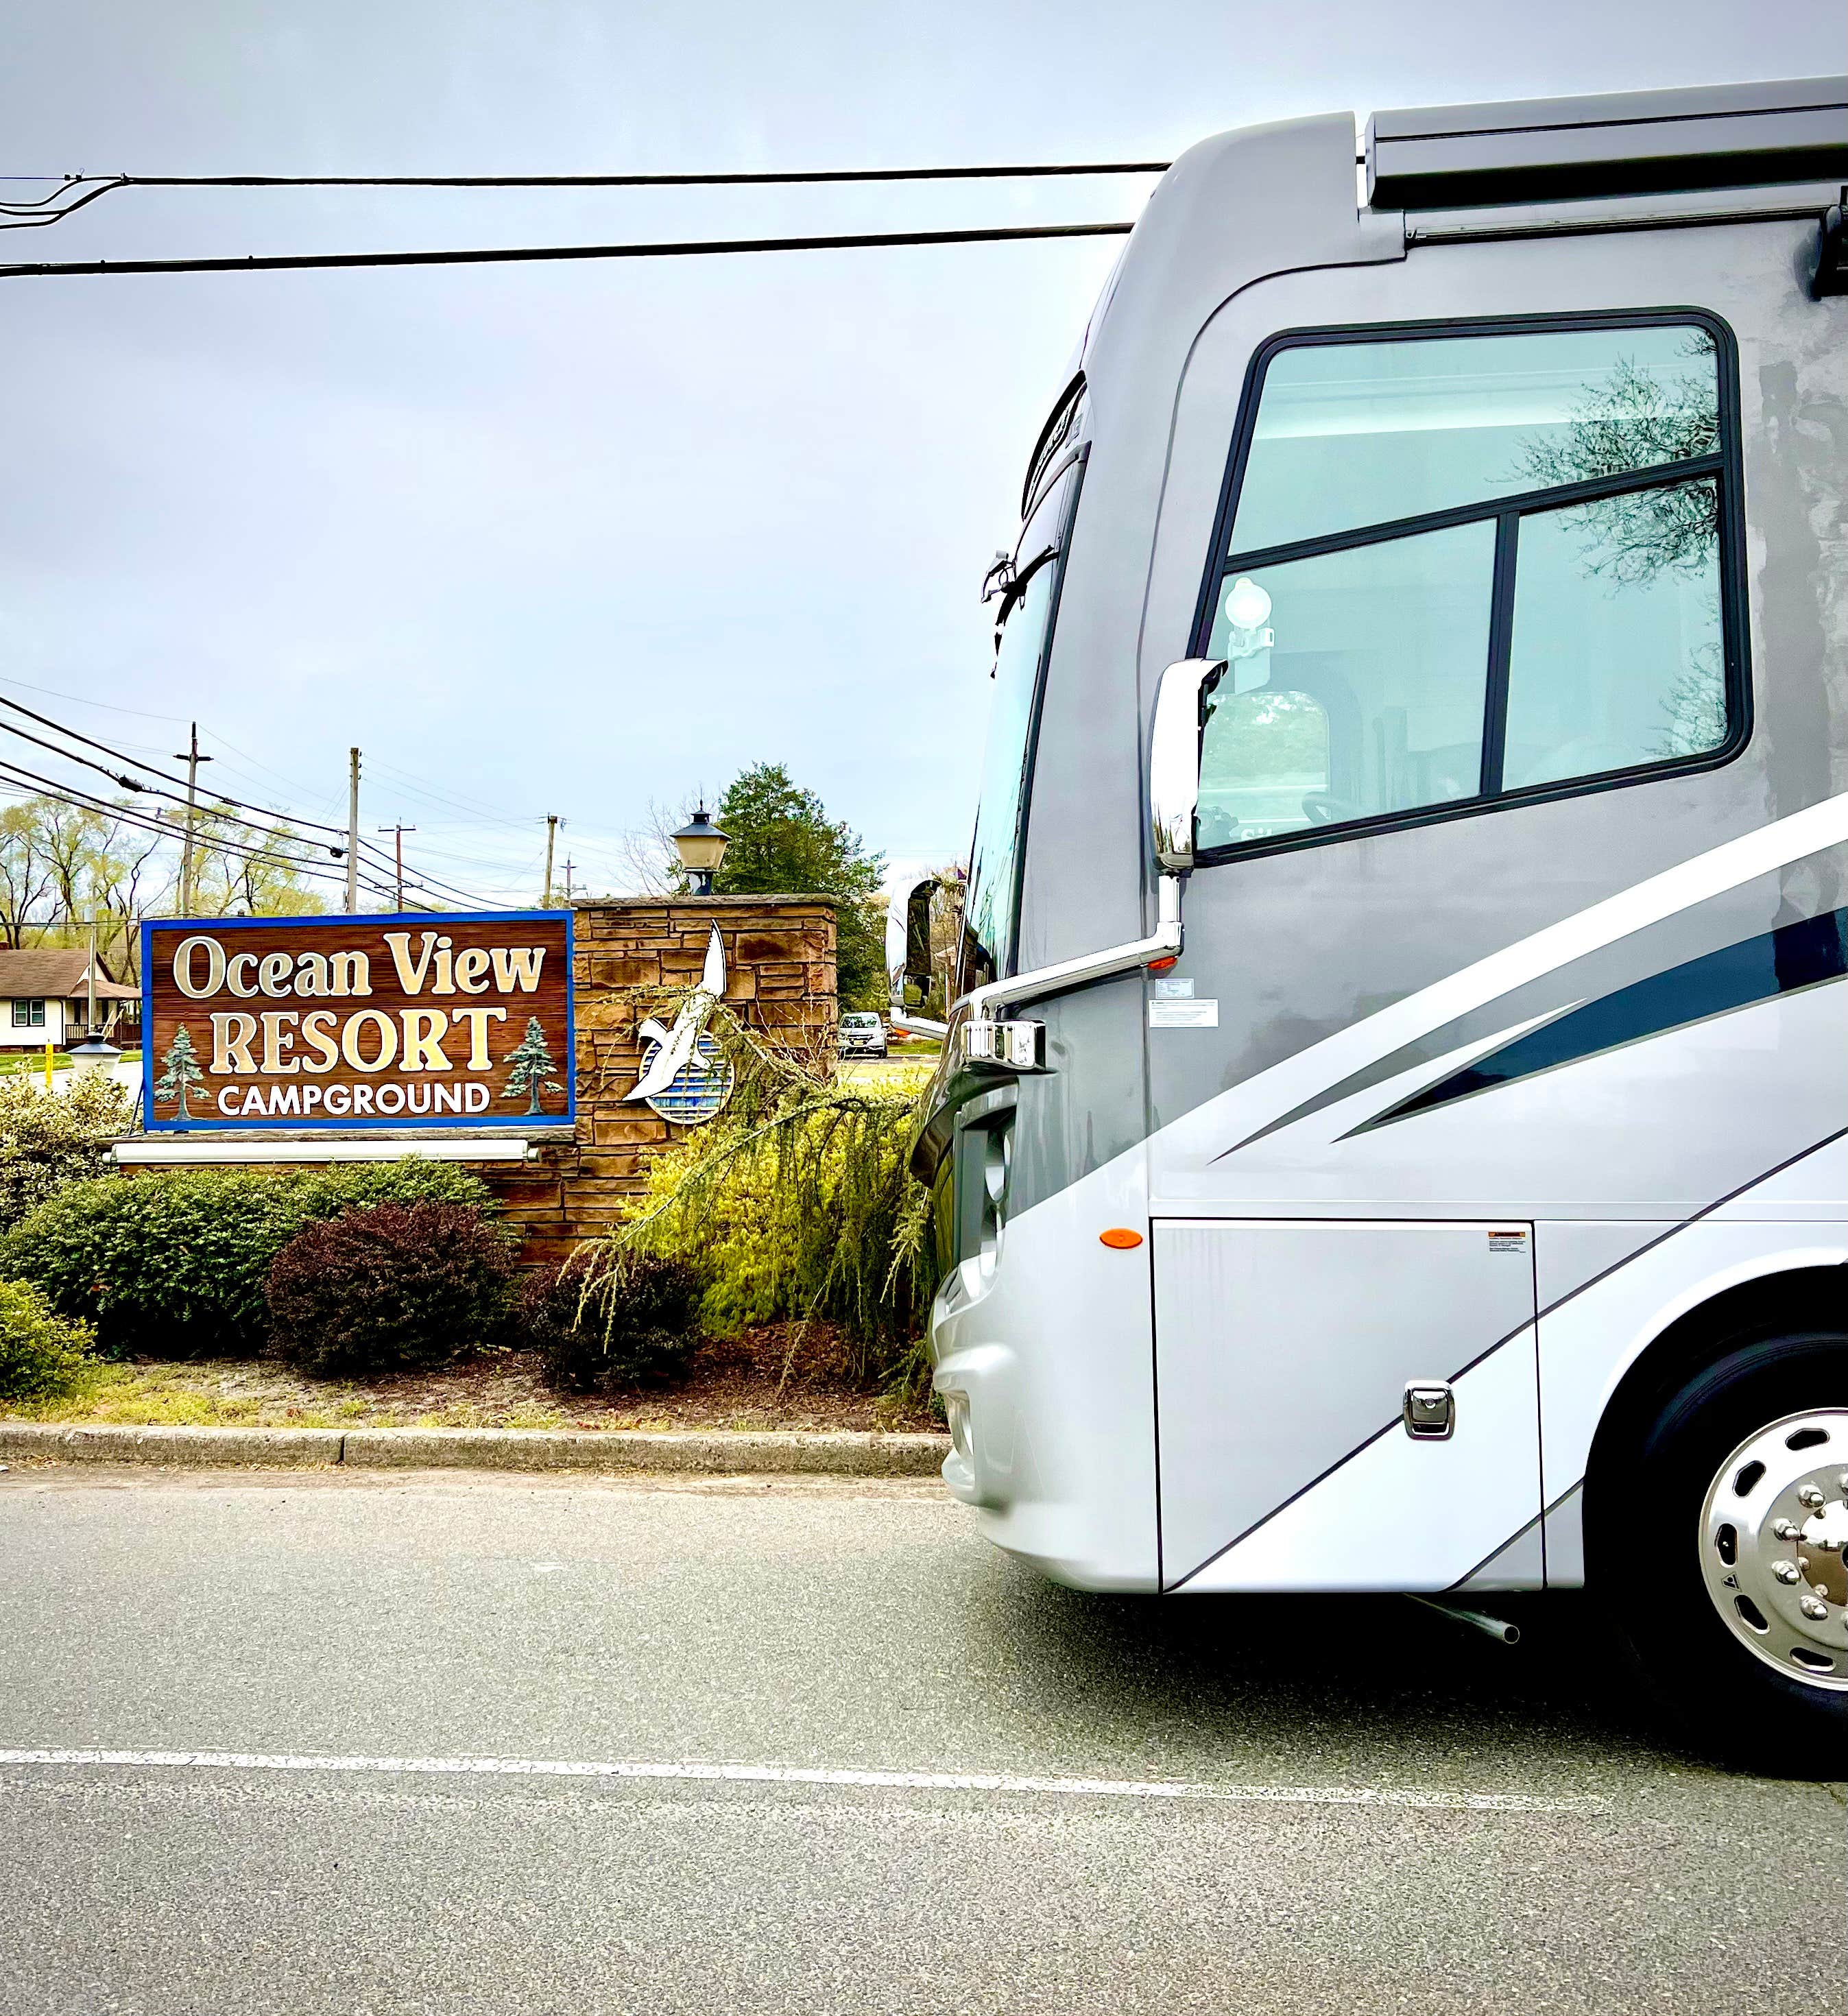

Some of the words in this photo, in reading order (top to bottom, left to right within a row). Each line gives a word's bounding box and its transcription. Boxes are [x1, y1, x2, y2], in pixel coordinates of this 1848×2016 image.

[173, 935, 372, 999] Ocean
[383, 931, 547, 996] View
[208, 1007, 507, 1074] RESORT
[217, 1083, 490, 1116] CAMPGROUND
